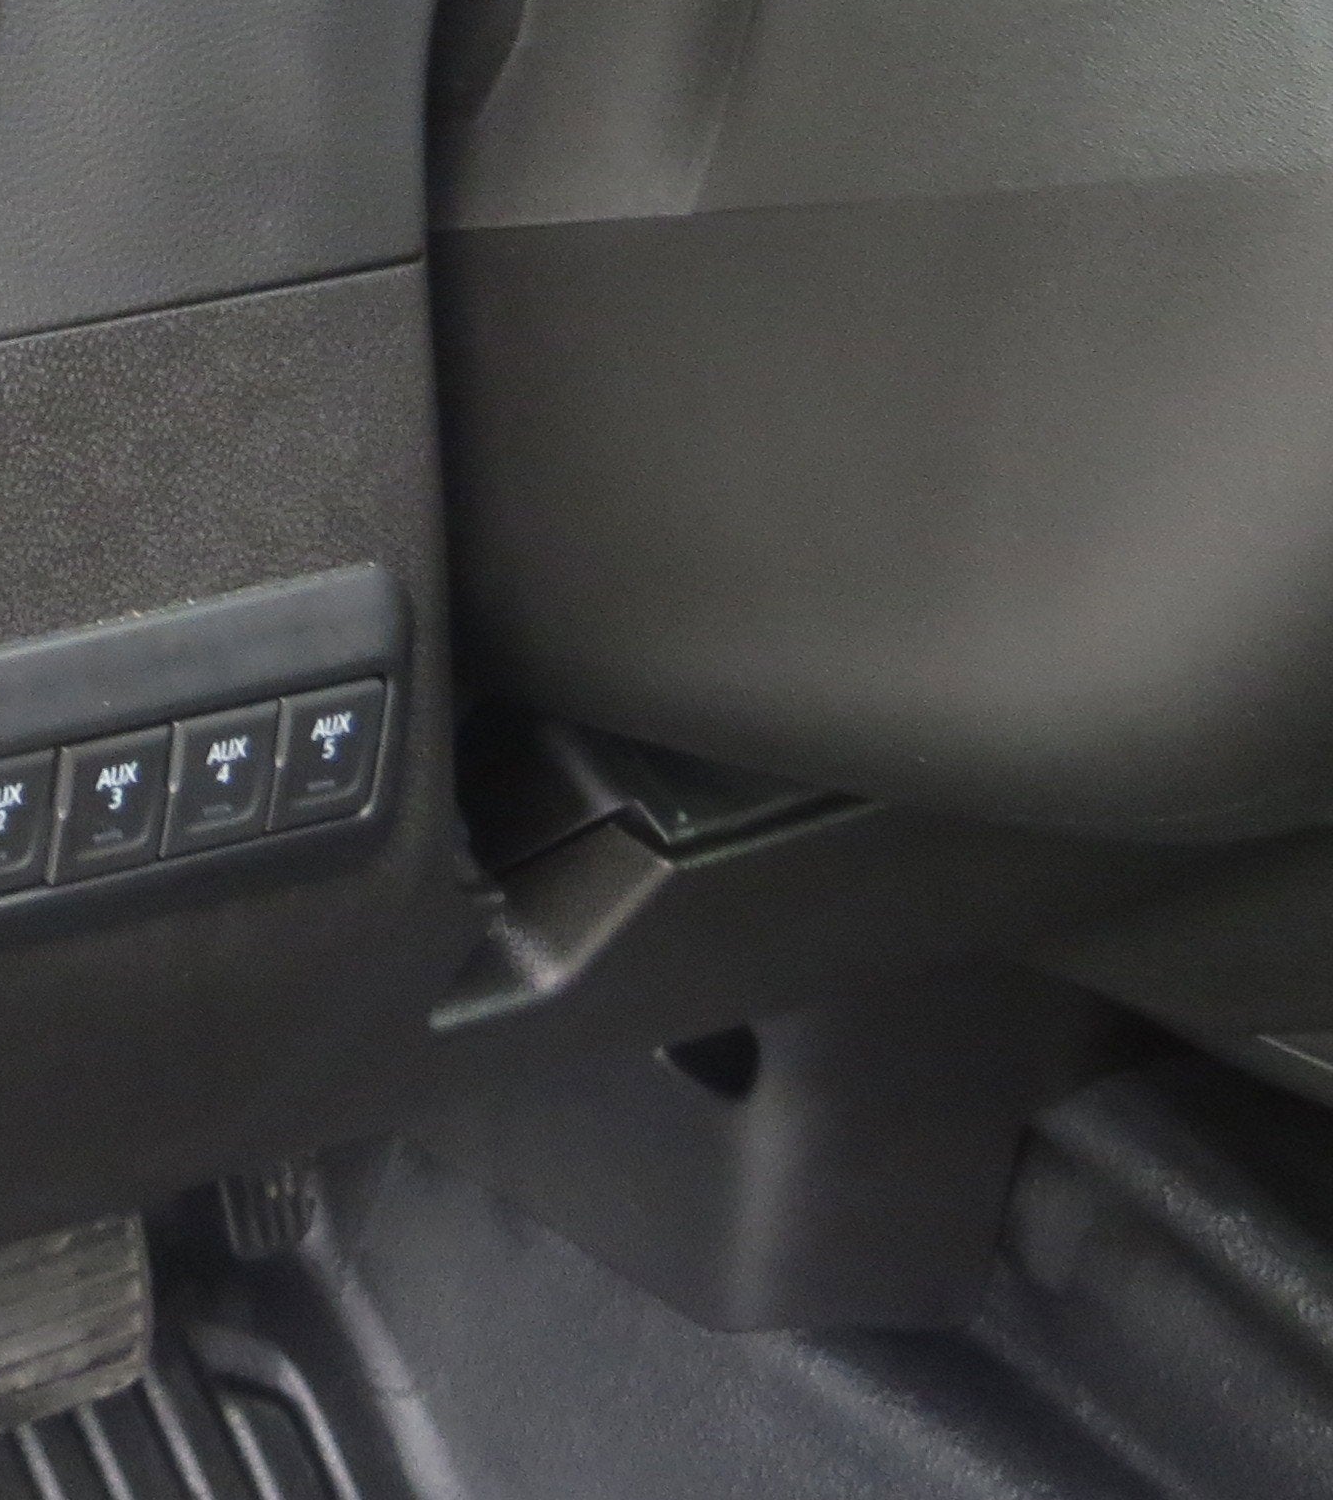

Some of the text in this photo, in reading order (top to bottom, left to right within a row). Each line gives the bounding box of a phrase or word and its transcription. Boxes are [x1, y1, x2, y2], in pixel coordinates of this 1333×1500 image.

[310, 711, 353, 741] AUX
[206, 736, 248, 766] AUX
[321, 737, 335, 760] 5
[95, 761, 139, 792] AUX
[215, 762, 230, 784] 4
[108, 786, 123, 810] 3
